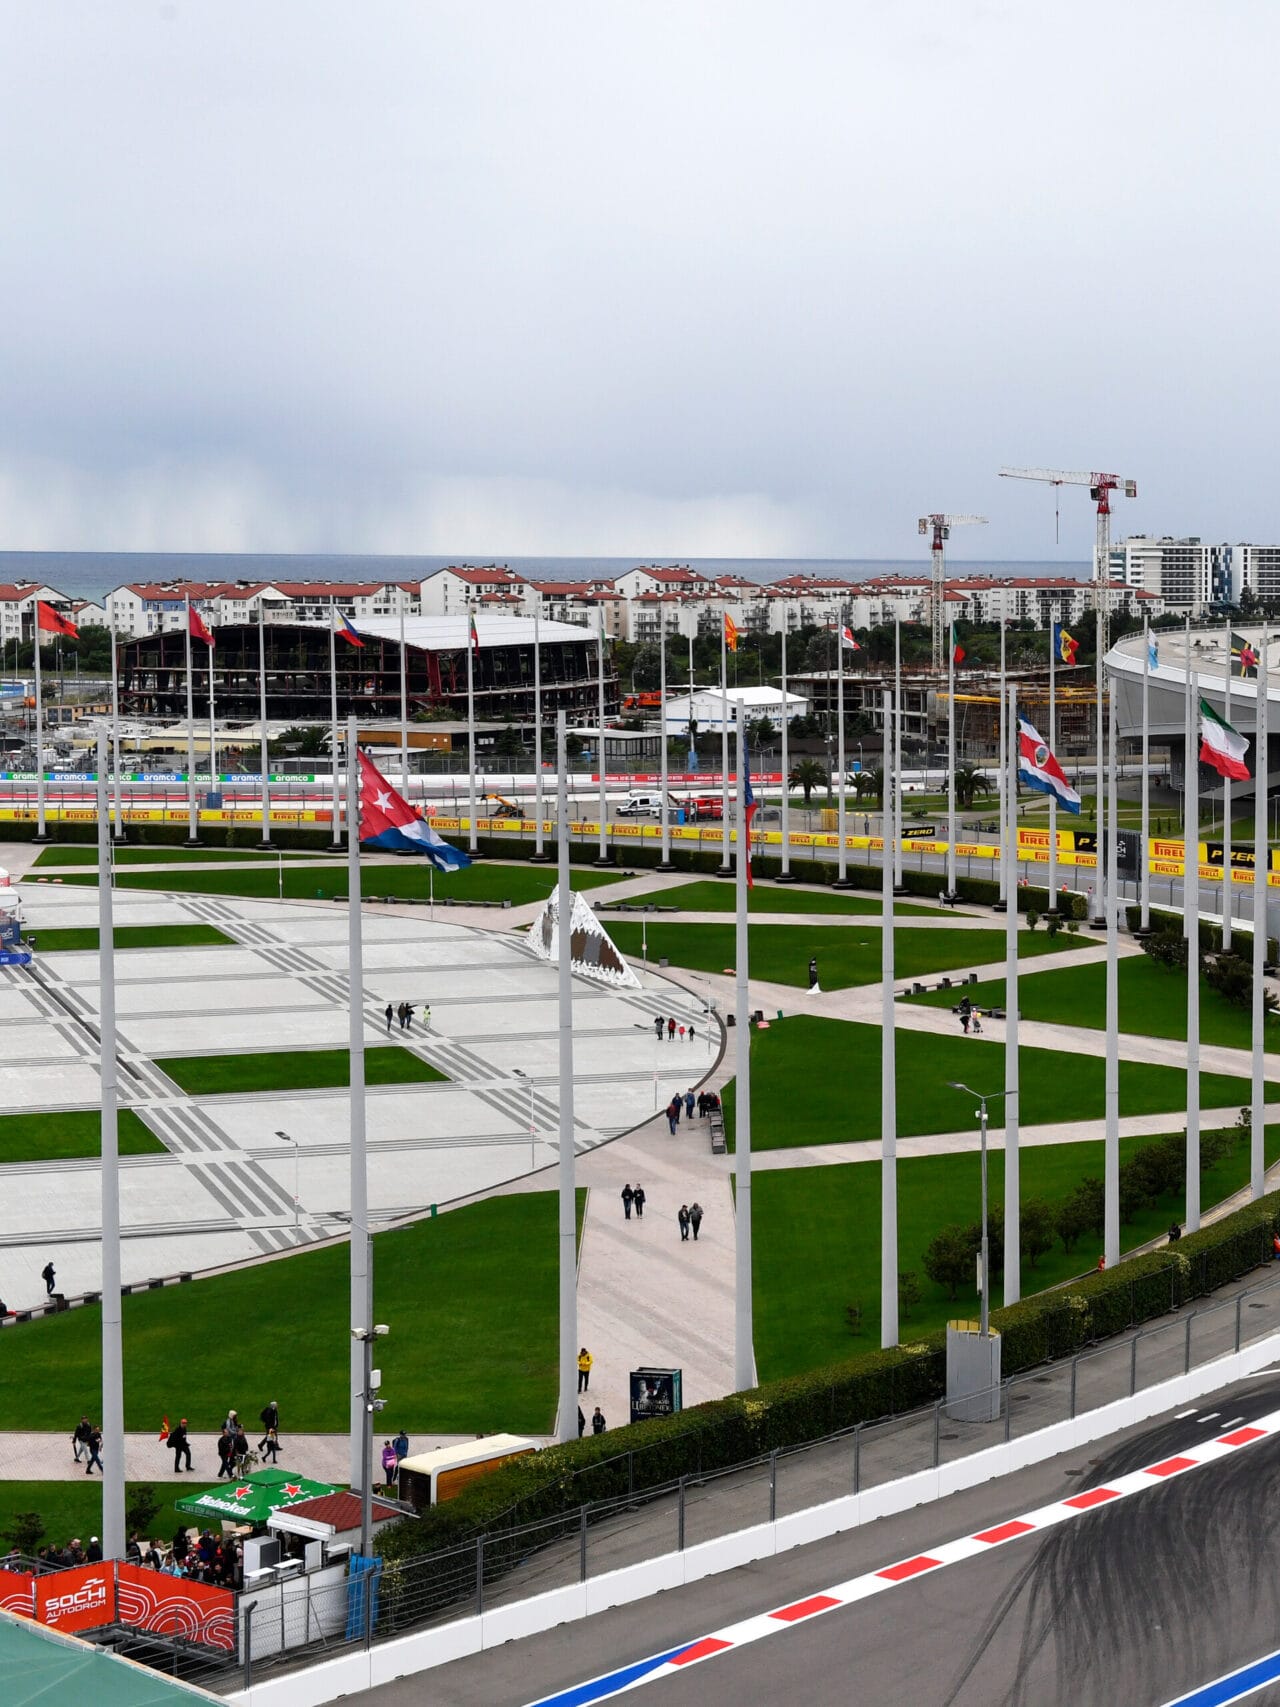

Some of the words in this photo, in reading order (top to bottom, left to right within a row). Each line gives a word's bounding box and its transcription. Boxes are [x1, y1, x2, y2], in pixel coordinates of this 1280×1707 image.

[1020, 831, 1060, 846] PIRELI
[1154, 842, 1185, 857] PIREL
[1230, 852, 1255, 862] ZER
[1155, 863, 1179, 873] PIRELLI
[1198, 866, 1219, 877] IRELLI
[195, 1494, 253, 1515] Heineken
[45, 1586, 106, 1611] SOCHI
[46, 1599, 107, 1619] AUTODROM
